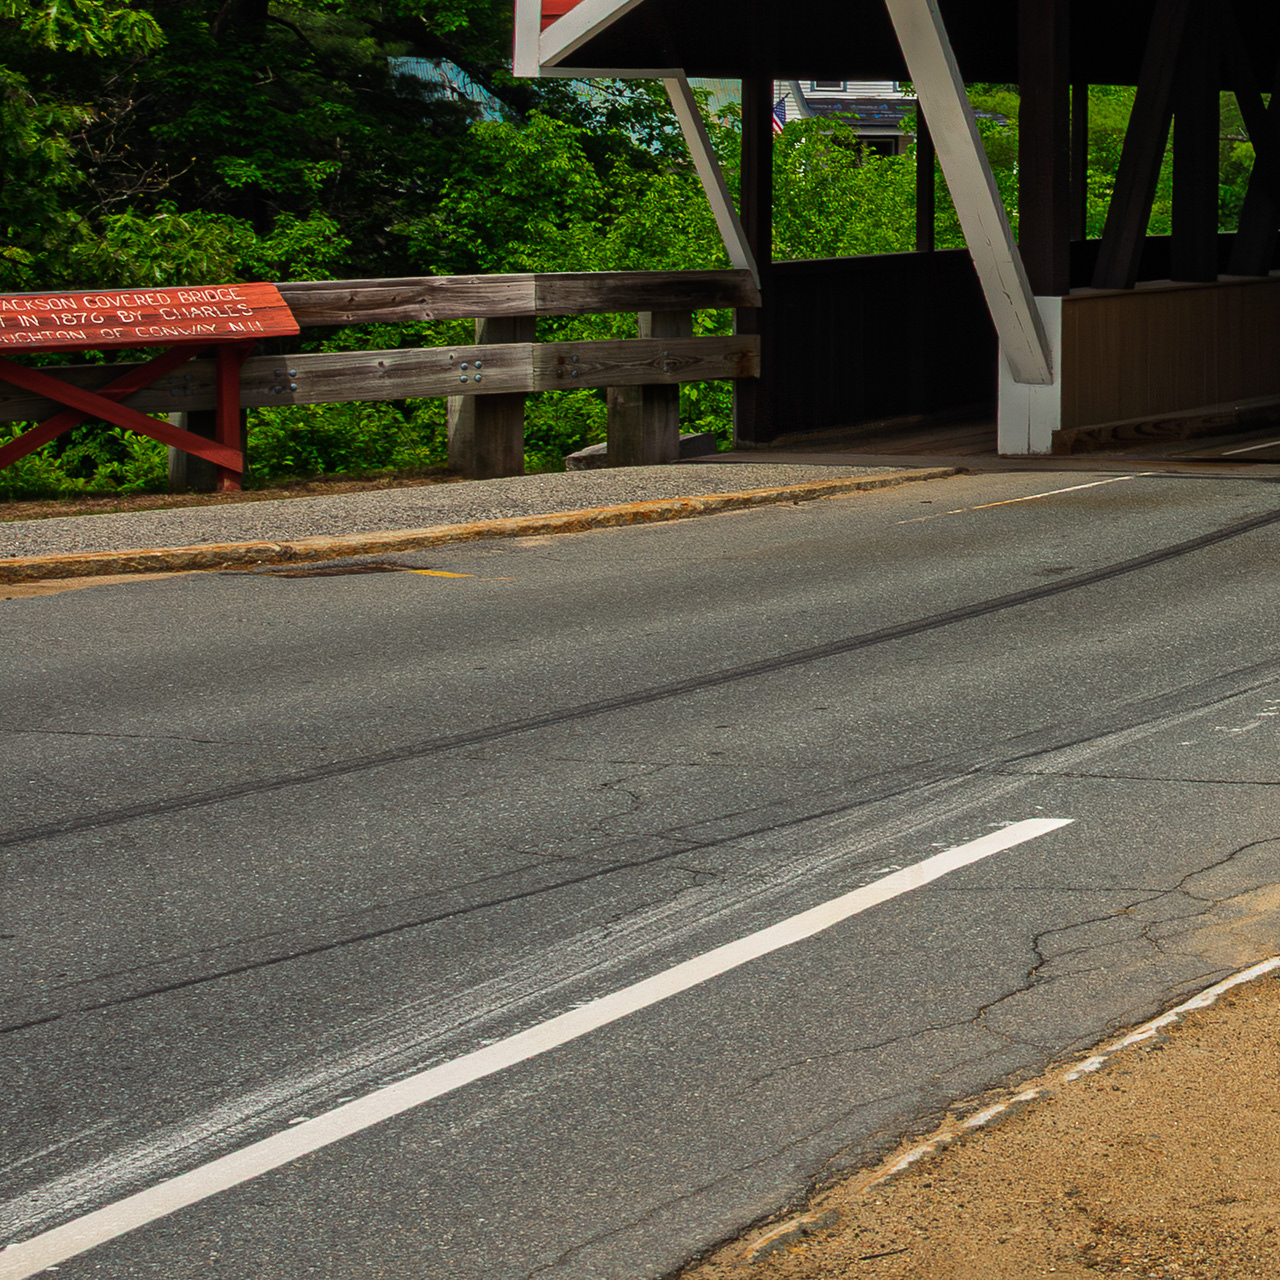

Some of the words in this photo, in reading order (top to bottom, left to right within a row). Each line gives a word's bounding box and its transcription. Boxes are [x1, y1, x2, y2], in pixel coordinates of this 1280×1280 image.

[0, 298, 78, 311] ACKSON
[82, 292, 171, 309] COVERED
[177, 287, 247, 304] BRIDGE
[17, 314, 40, 327] IN
[116, 310, 142, 323] BY
[159, 303, 254, 320] CHARLES
[0, 329, 87, 343] UGHTON
[100, 327, 124, 339] OF
[135, 323, 217, 338] CONWAY
